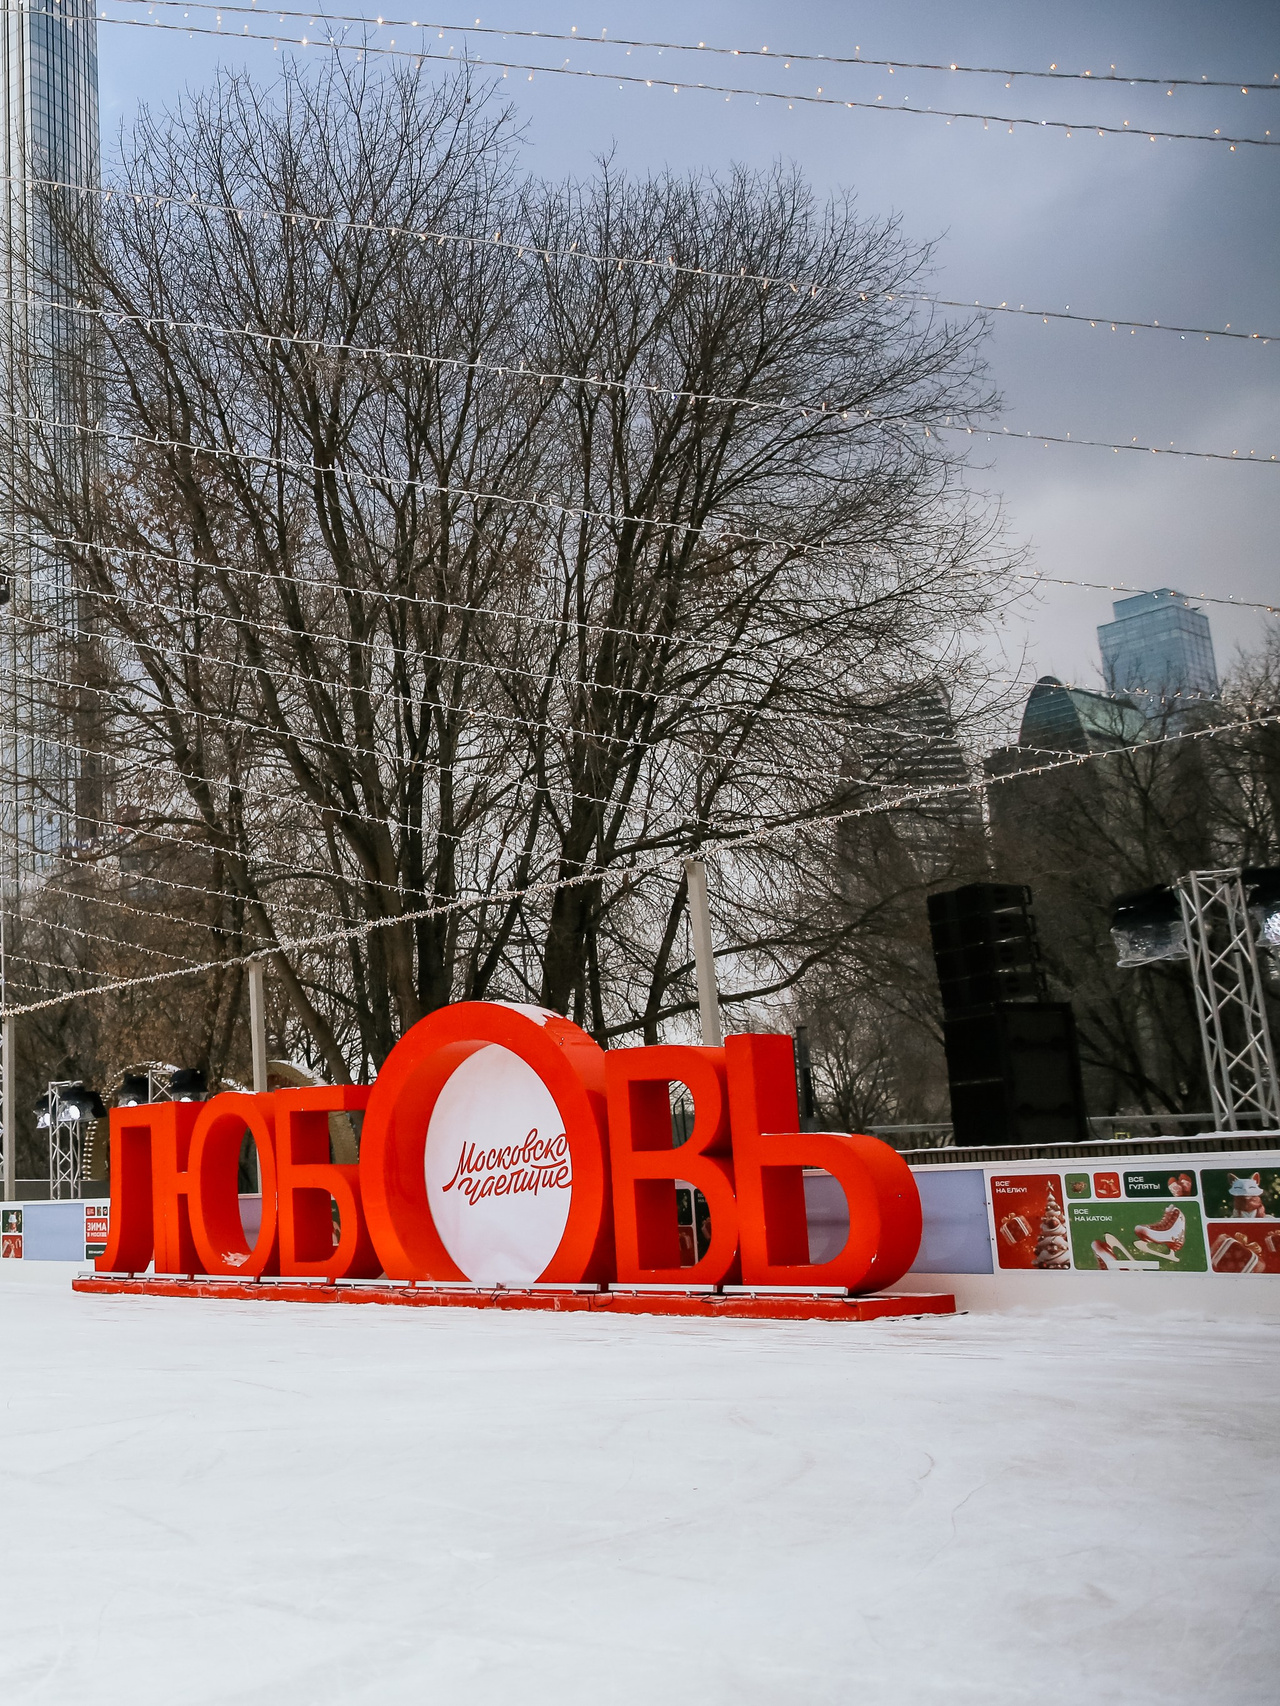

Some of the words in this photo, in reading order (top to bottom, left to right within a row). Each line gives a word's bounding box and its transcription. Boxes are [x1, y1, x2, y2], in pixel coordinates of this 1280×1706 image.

[96, 1000, 923, 1295] ЛЮБОВЬ
[442, 1127, 568, 1193] Московско
[87, 1222, 106, 1231] ЗИМА
